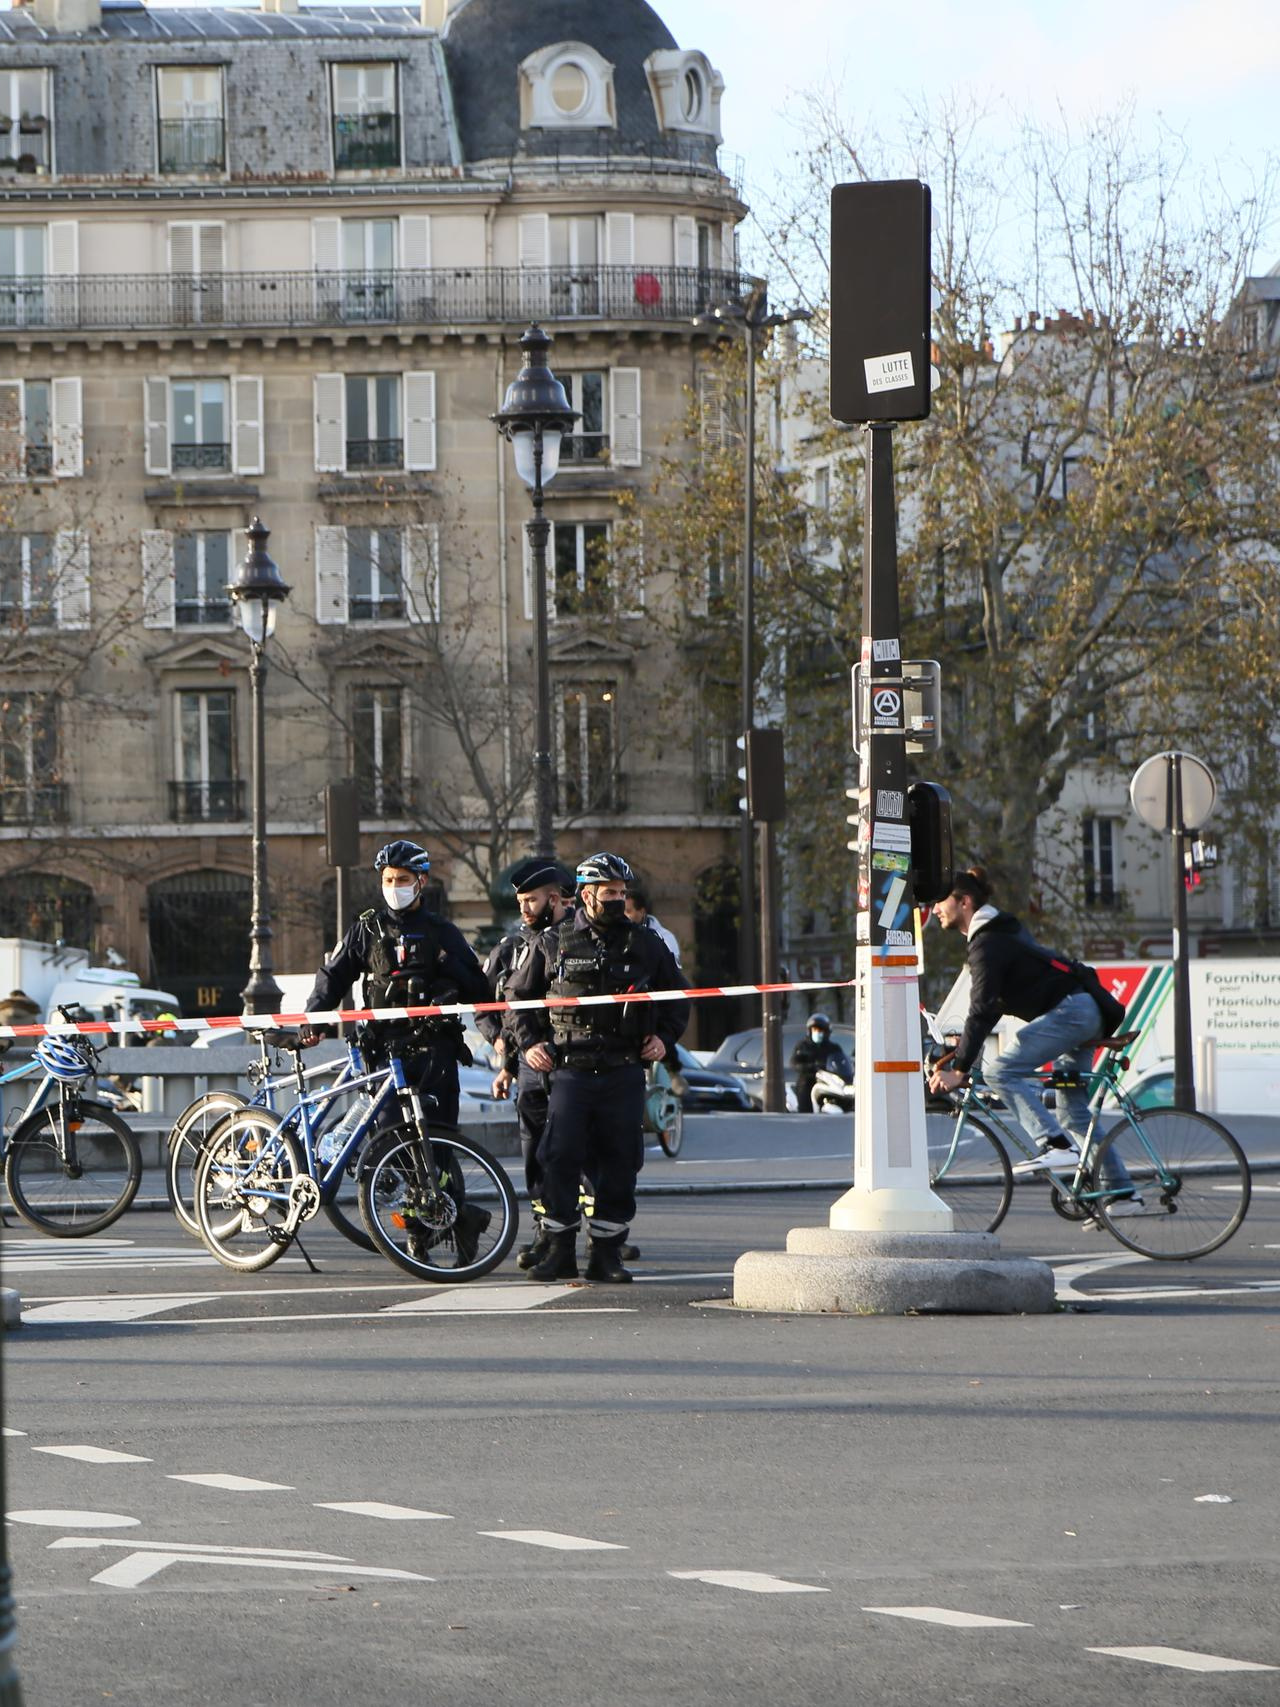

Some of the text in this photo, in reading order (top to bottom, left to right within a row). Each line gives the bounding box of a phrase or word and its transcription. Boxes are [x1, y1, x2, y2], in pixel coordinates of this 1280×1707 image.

[882, 359, 909, 374] LUTTE
[872, 374, 909, 387] DES CLASSES
